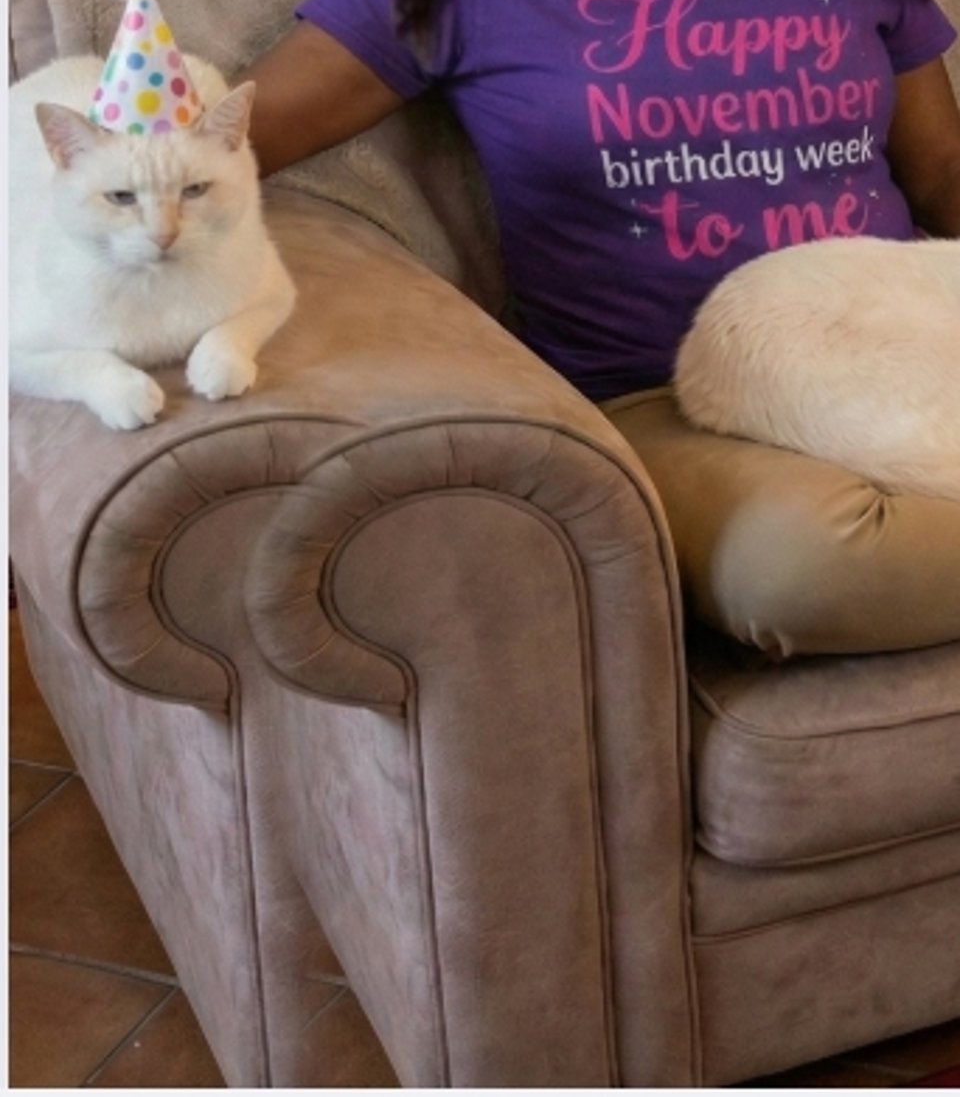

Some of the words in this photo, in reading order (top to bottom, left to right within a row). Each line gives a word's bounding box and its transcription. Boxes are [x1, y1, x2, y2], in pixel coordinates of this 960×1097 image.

[587, 67, 880, 143] November
[601, 140, 785, 188] birthday
[796, 125, 874, 172] week
[640, 190, 744, 261] to
